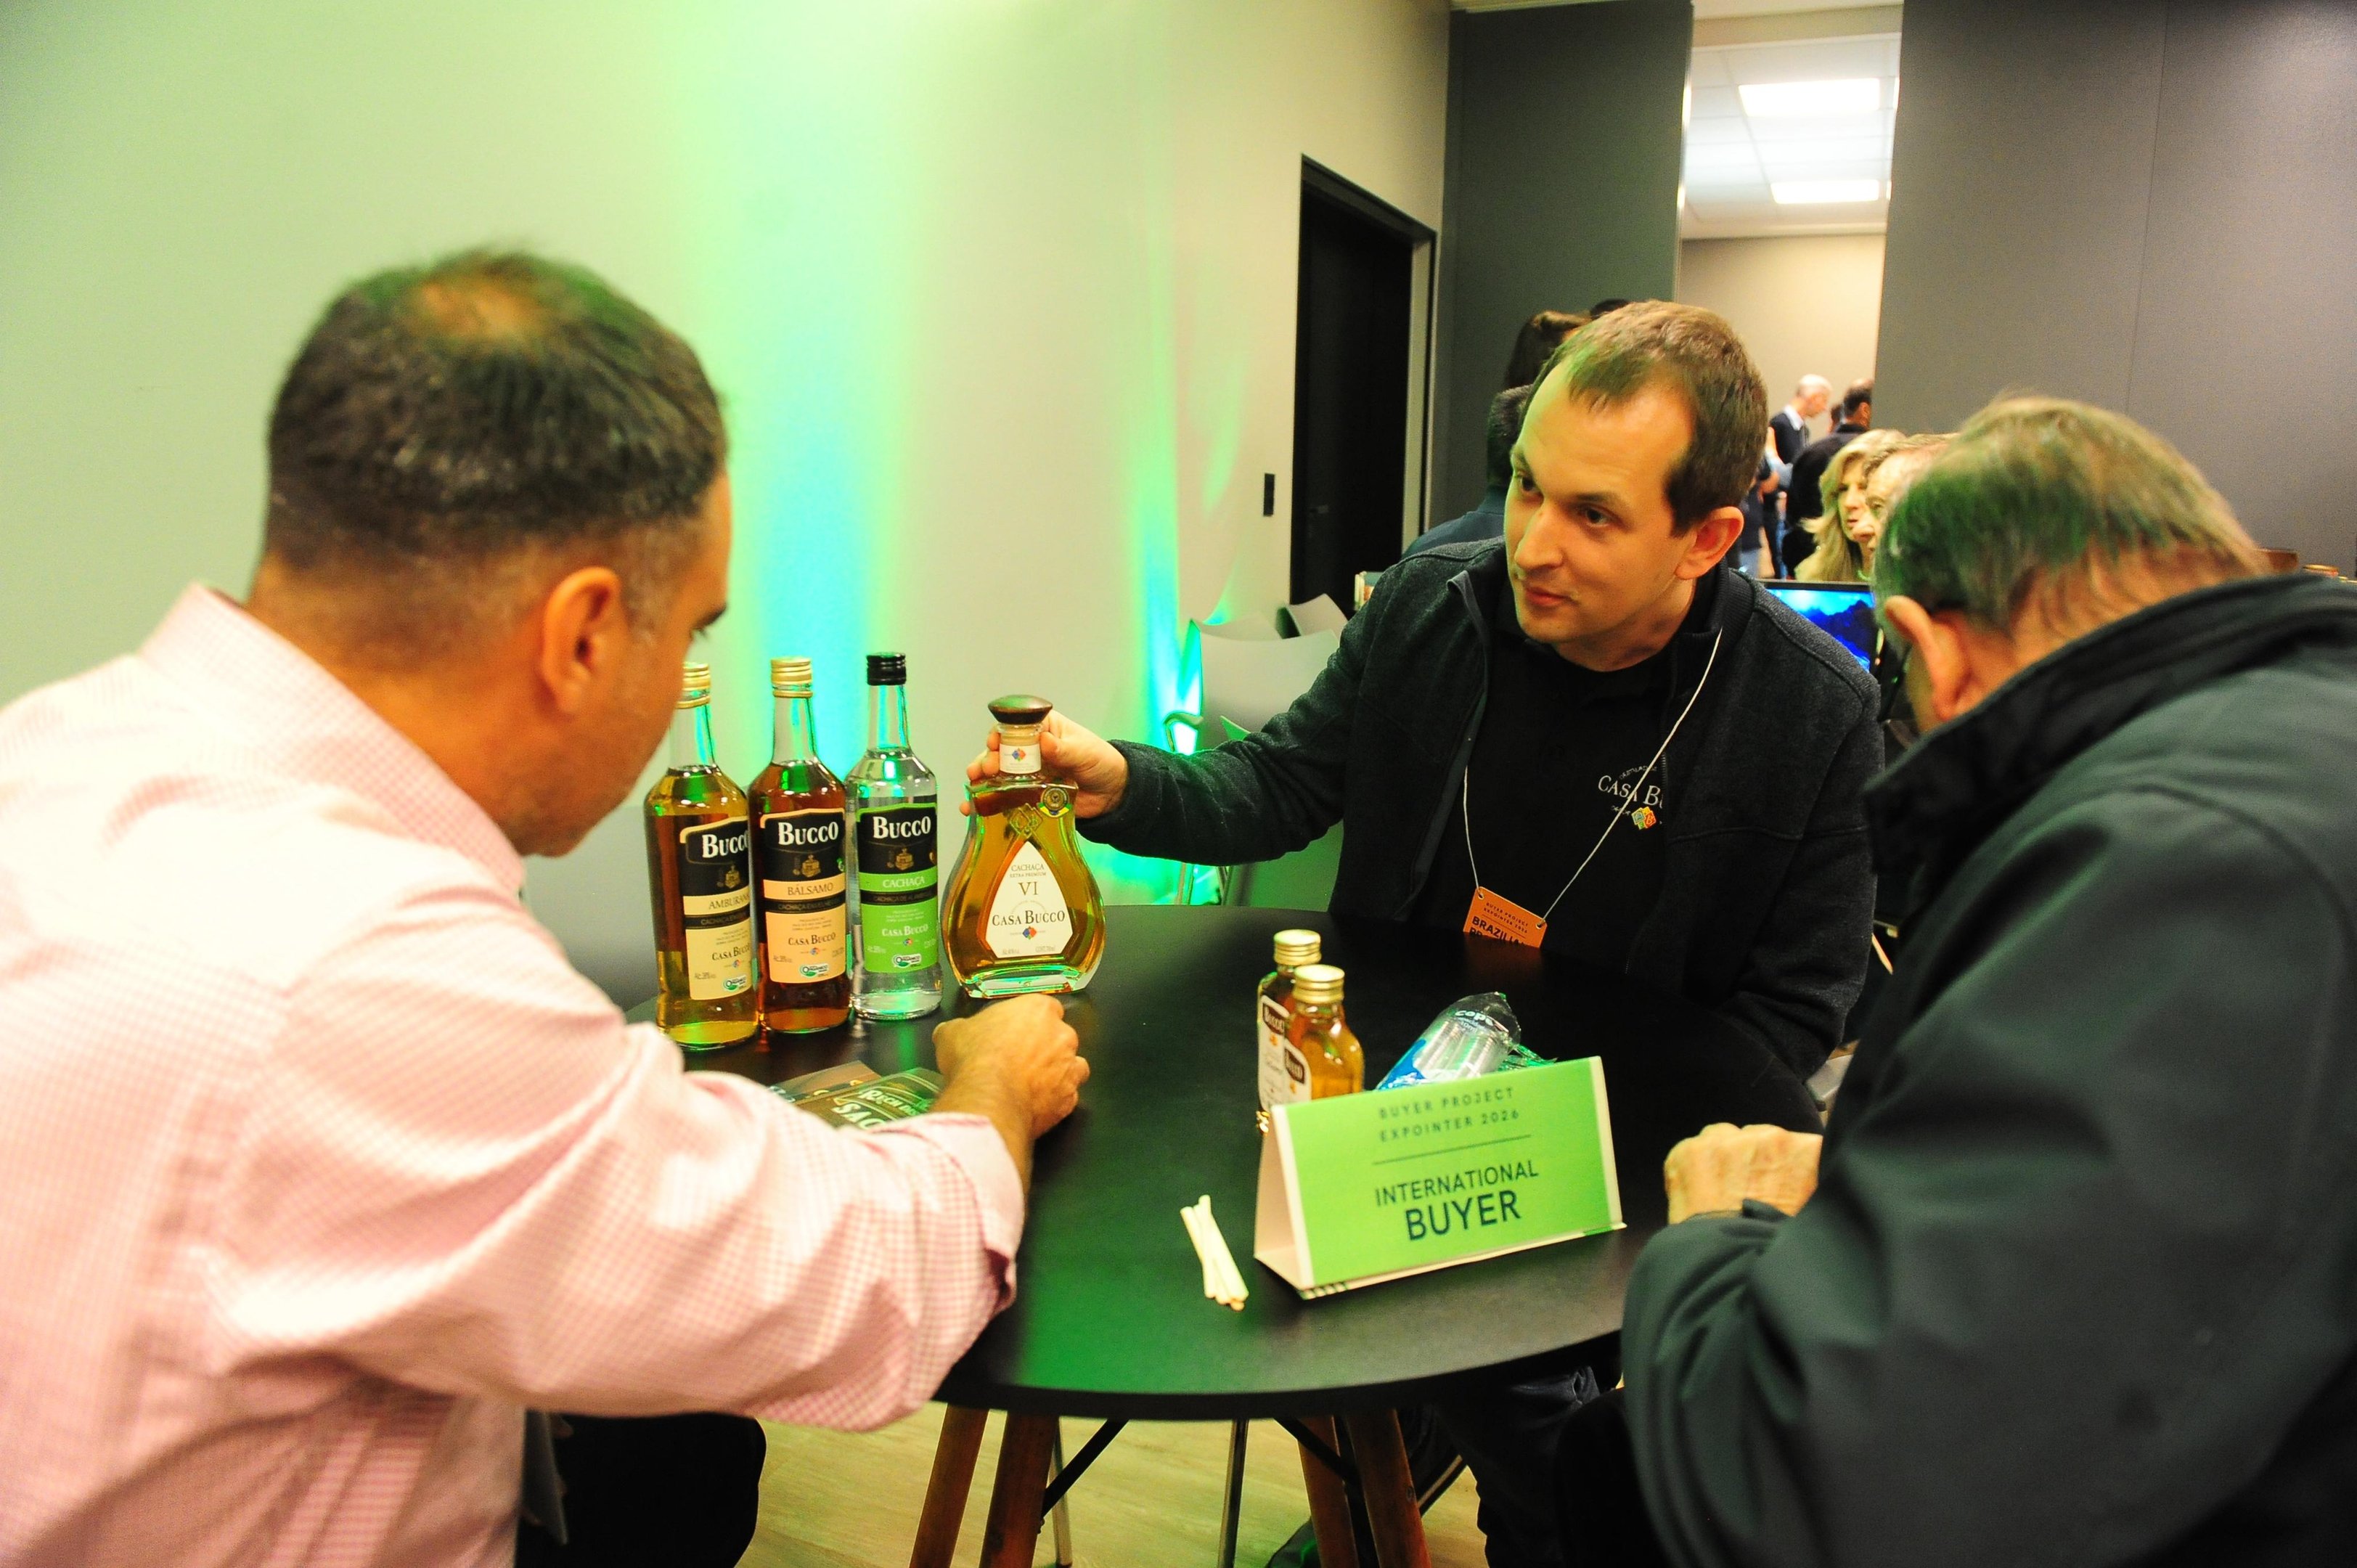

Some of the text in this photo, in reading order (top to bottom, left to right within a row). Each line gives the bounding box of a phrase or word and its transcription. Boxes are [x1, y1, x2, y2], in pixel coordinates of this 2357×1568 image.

[777, 822, 839, 846] BUCCO
[873, 816, 931, 839] BUCCO
[882, 875, 926, 888] CACHAÇA
[1018, 881, 1038, 896] VI
[992, 910, 1066, 926] CASA BUCCO
[788, 937, 809, 946] CASA
[882, 928, 903, 936] CASA
[711, 952, 732, 961] CASA
[1380, 1087, 1513, 1119] BUYER PROJECT
[1381, 1109, 1519, 1142] EXPOINTER 2026
[1375, 1160, 1540, 1207] INTERNATIONAL
[1405, 1190, 1522, 1241] BUYER
